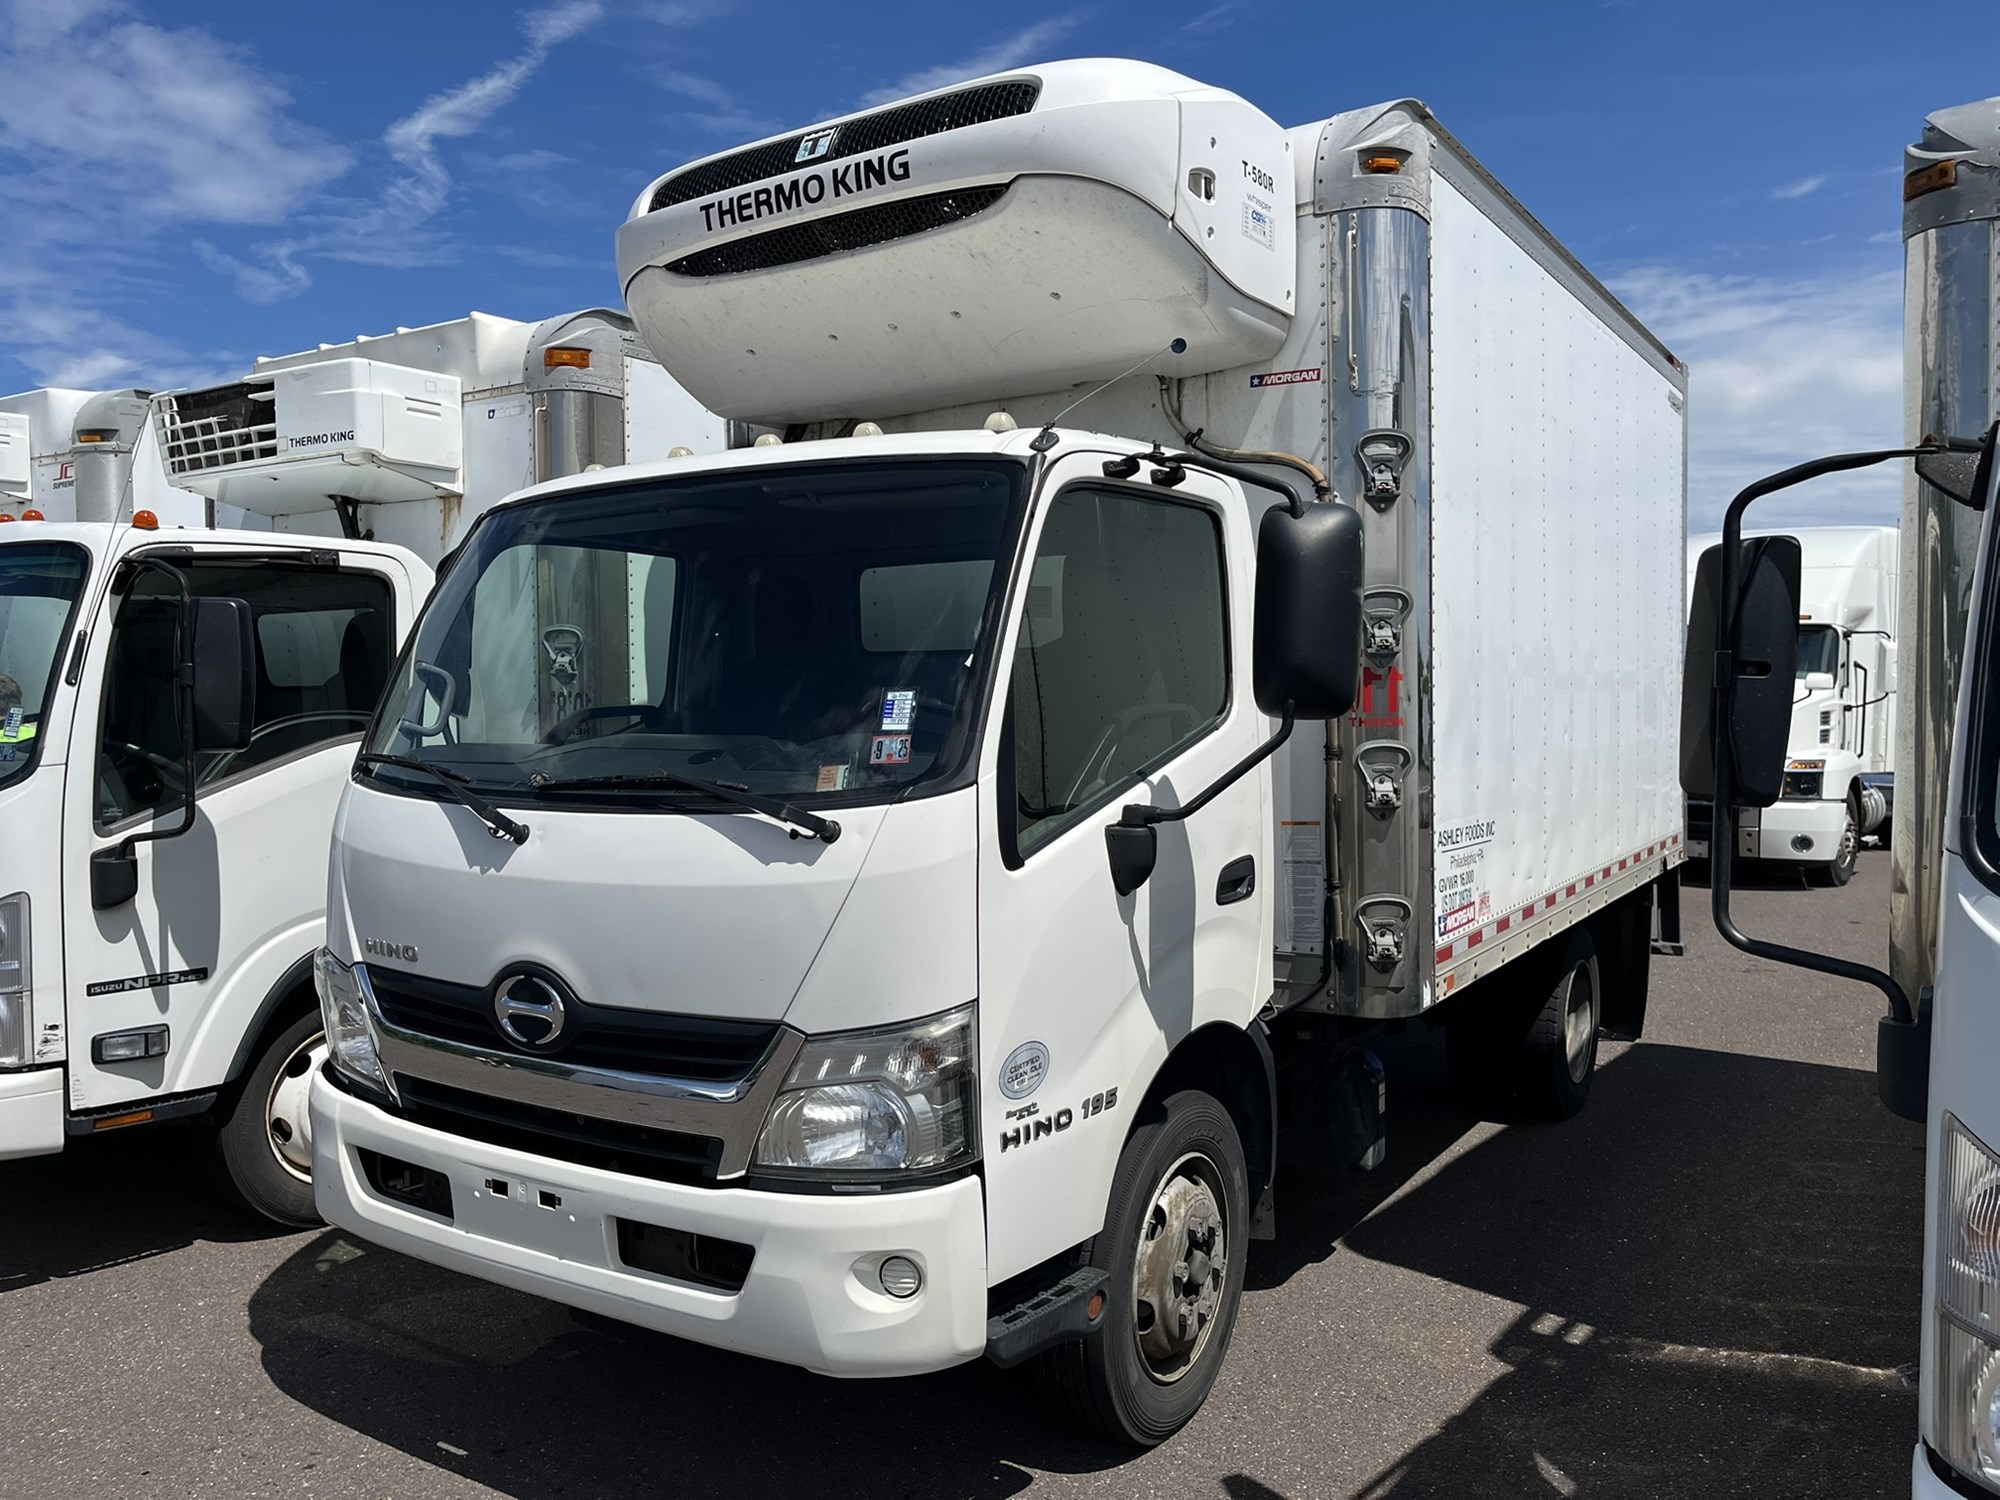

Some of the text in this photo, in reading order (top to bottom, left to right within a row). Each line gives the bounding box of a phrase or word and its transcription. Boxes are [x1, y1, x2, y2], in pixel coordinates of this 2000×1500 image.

[1242, 160, 1275, 194] T-580R
[699, 149, 911, 232] THERMO KING
[1262, 370, 1319, 385] MORGAN
[289, 430, 355, 448] THERMO KING
[1437, 820, 1496, 848] ASHLEY FOODS INC
[1438, 874, 1459, 893] GVWR
[1445, 903, 1475, 931] MORGAN
[365, 937, 419, 963] HINO
[91, 972, 204, 994] ISUZU NPR HD
[1007, 1068, 1028, 1084] CLEAN
[1029, 1062, 1043, 1074] IDLE
[1009, 1055, 1041, 1074] CERTIFIED
[999, 1086, 1118, 1154] HINO 195
